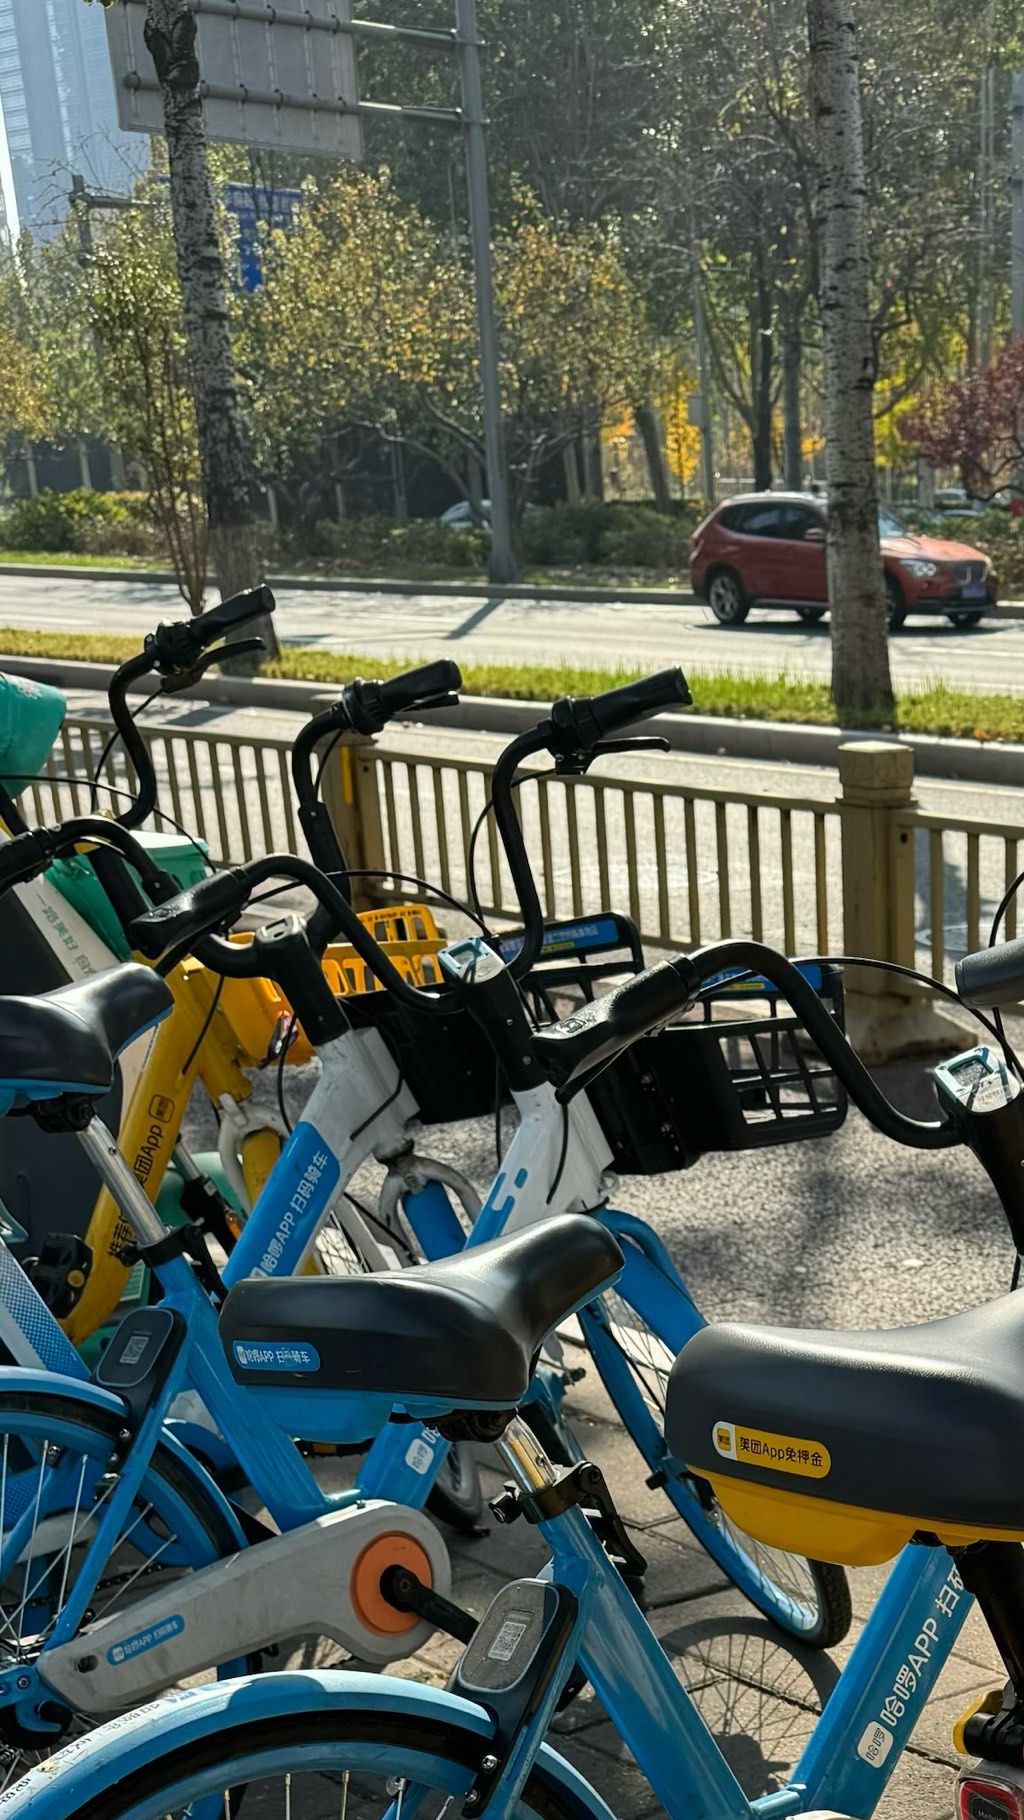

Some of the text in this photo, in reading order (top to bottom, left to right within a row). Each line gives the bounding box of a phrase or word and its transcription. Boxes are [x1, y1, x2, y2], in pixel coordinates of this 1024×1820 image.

[260, 1150, 328, 1274] 哈啰APP 扫码骑车
[739, 1436, 823, 1467] 美团App免押金
[880, 1617, 939, 1727] 哈啰APP
[865, 1727, 885, 1762] 哈啰
